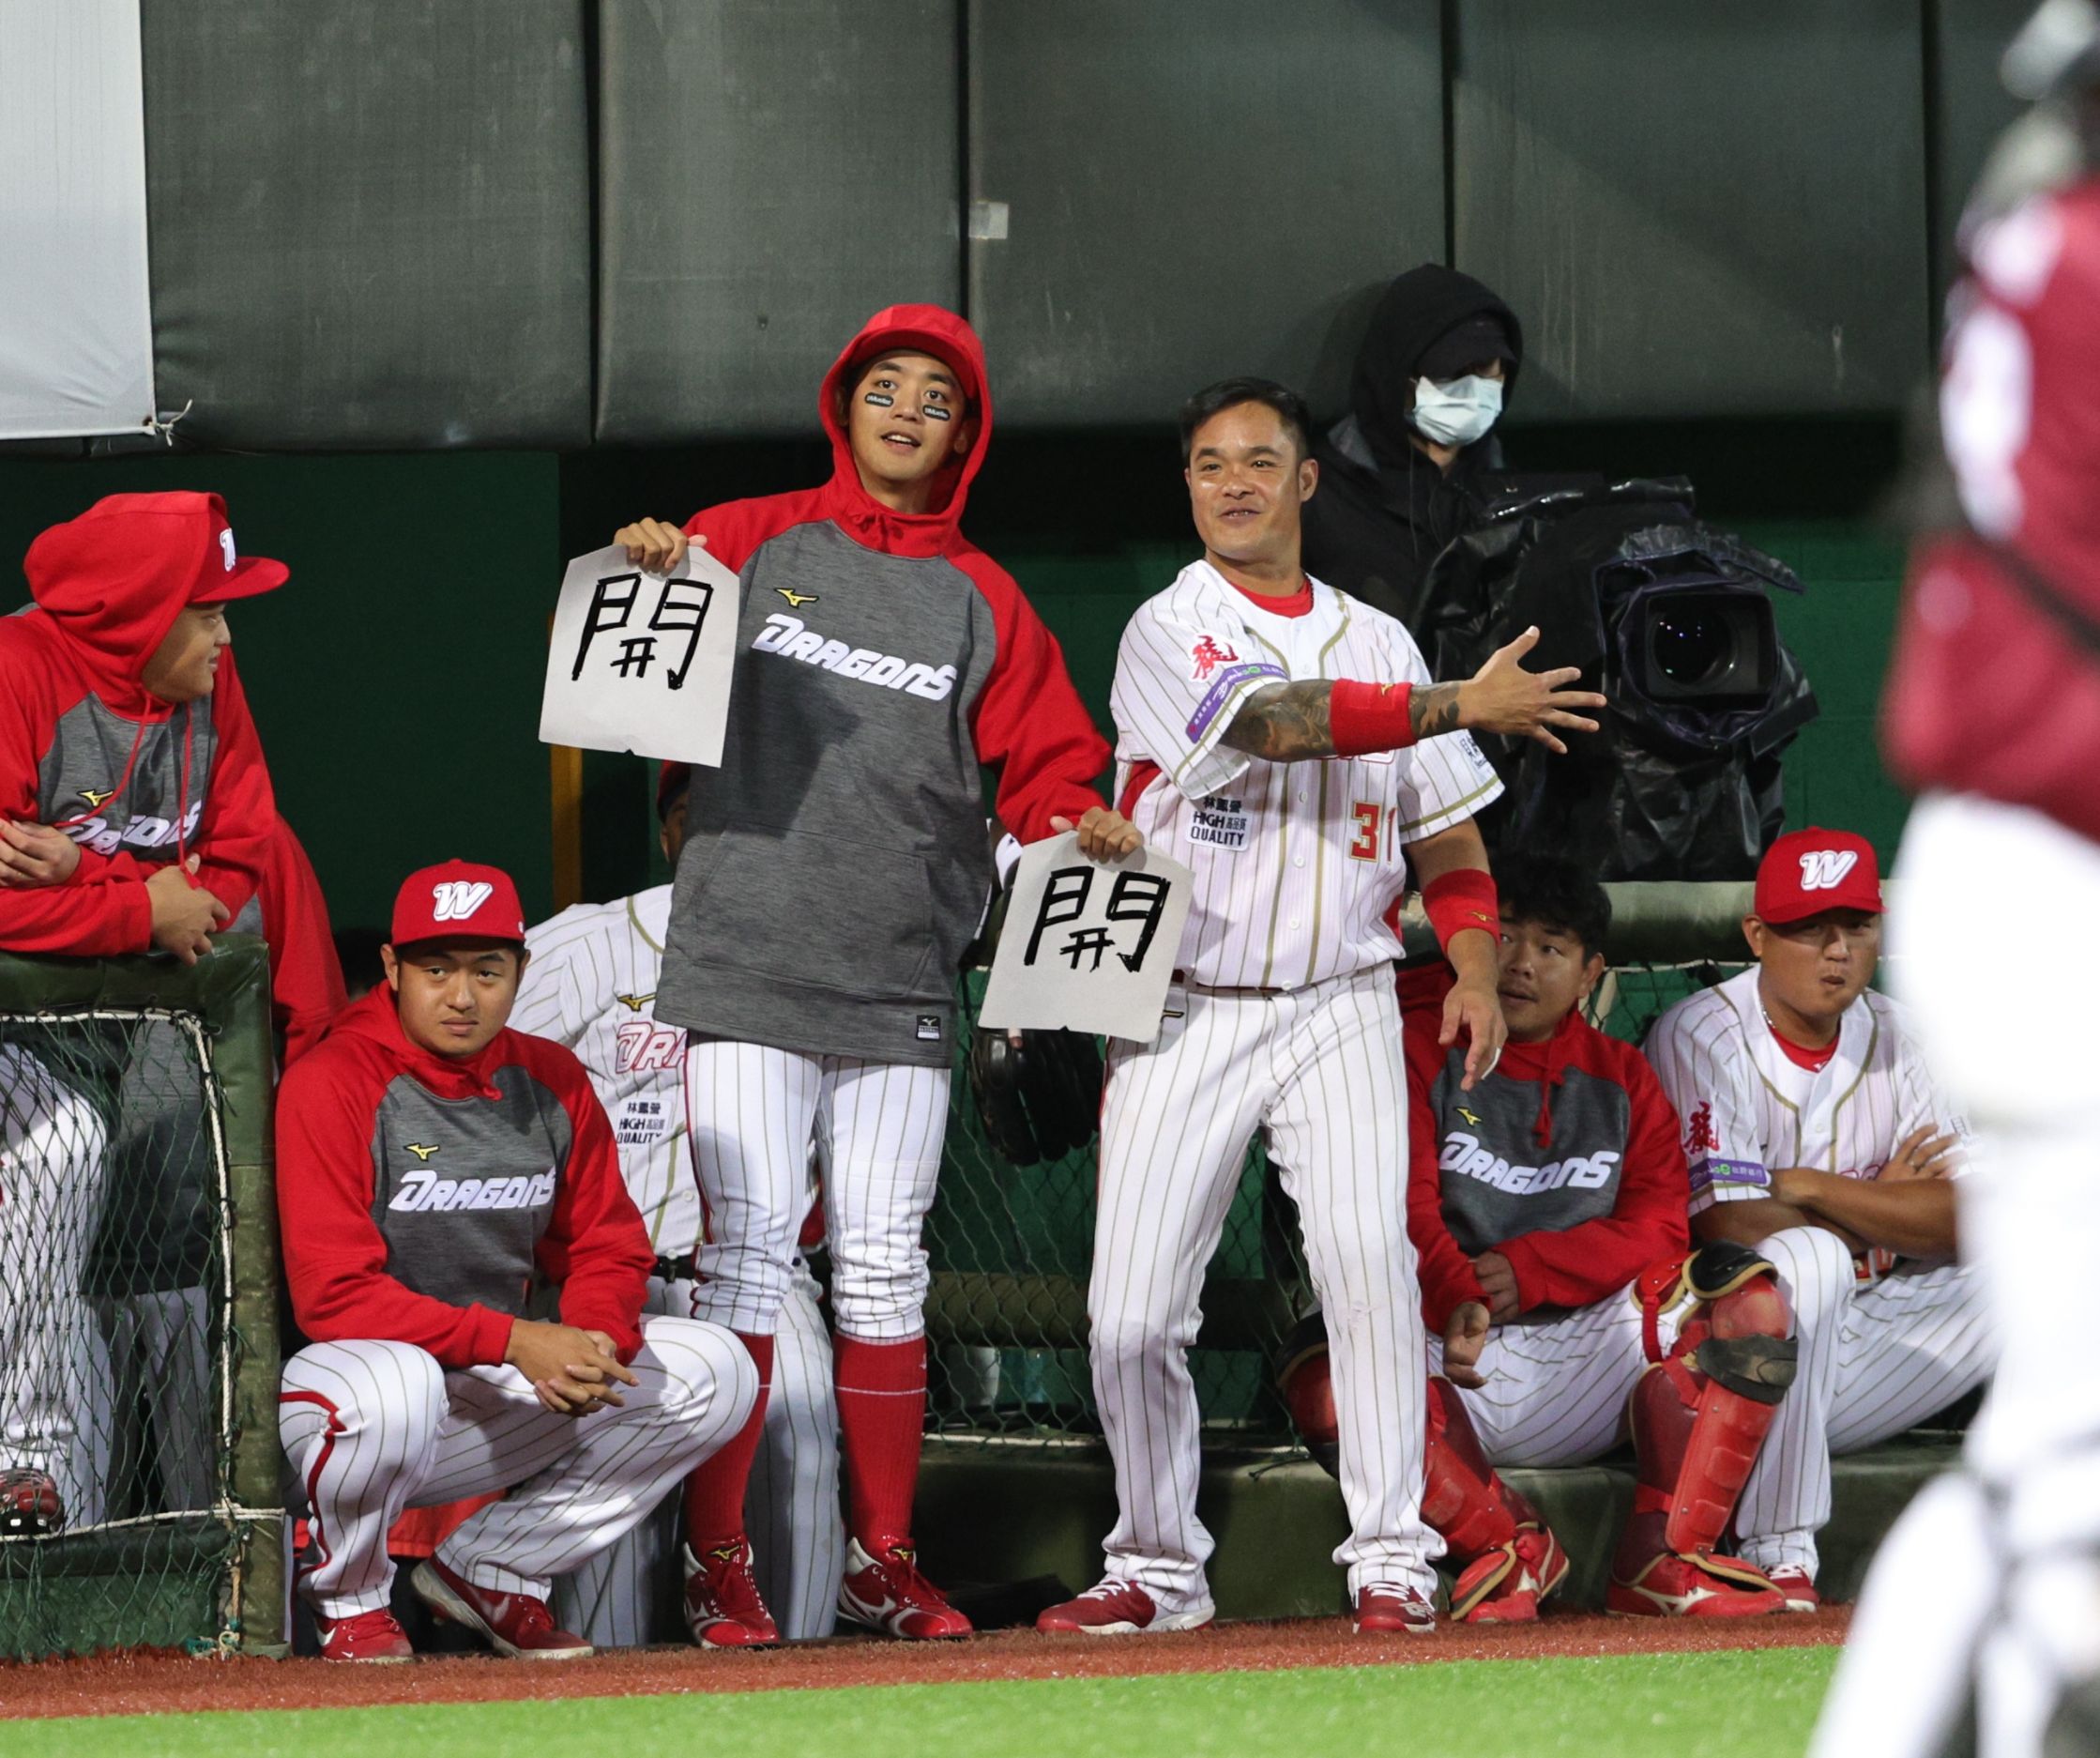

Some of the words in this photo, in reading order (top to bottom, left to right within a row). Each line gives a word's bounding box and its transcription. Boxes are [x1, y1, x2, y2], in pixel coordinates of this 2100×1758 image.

[571, 572, 714, 691] 開
[751, 613, 958, 701] DRAGONS
[1191, 826, 1244, 847] QUALITY
[1194, 811, 1225, 829] HIGH
[1799, 849, 1858, 891] W
[433, 880, 493, 921] W
[1024, 865, 1171, 972] 開
[1439, 1132, 1620, 1195] DRAGONS
[388, 1167, 555, 1213] DRAGONS
